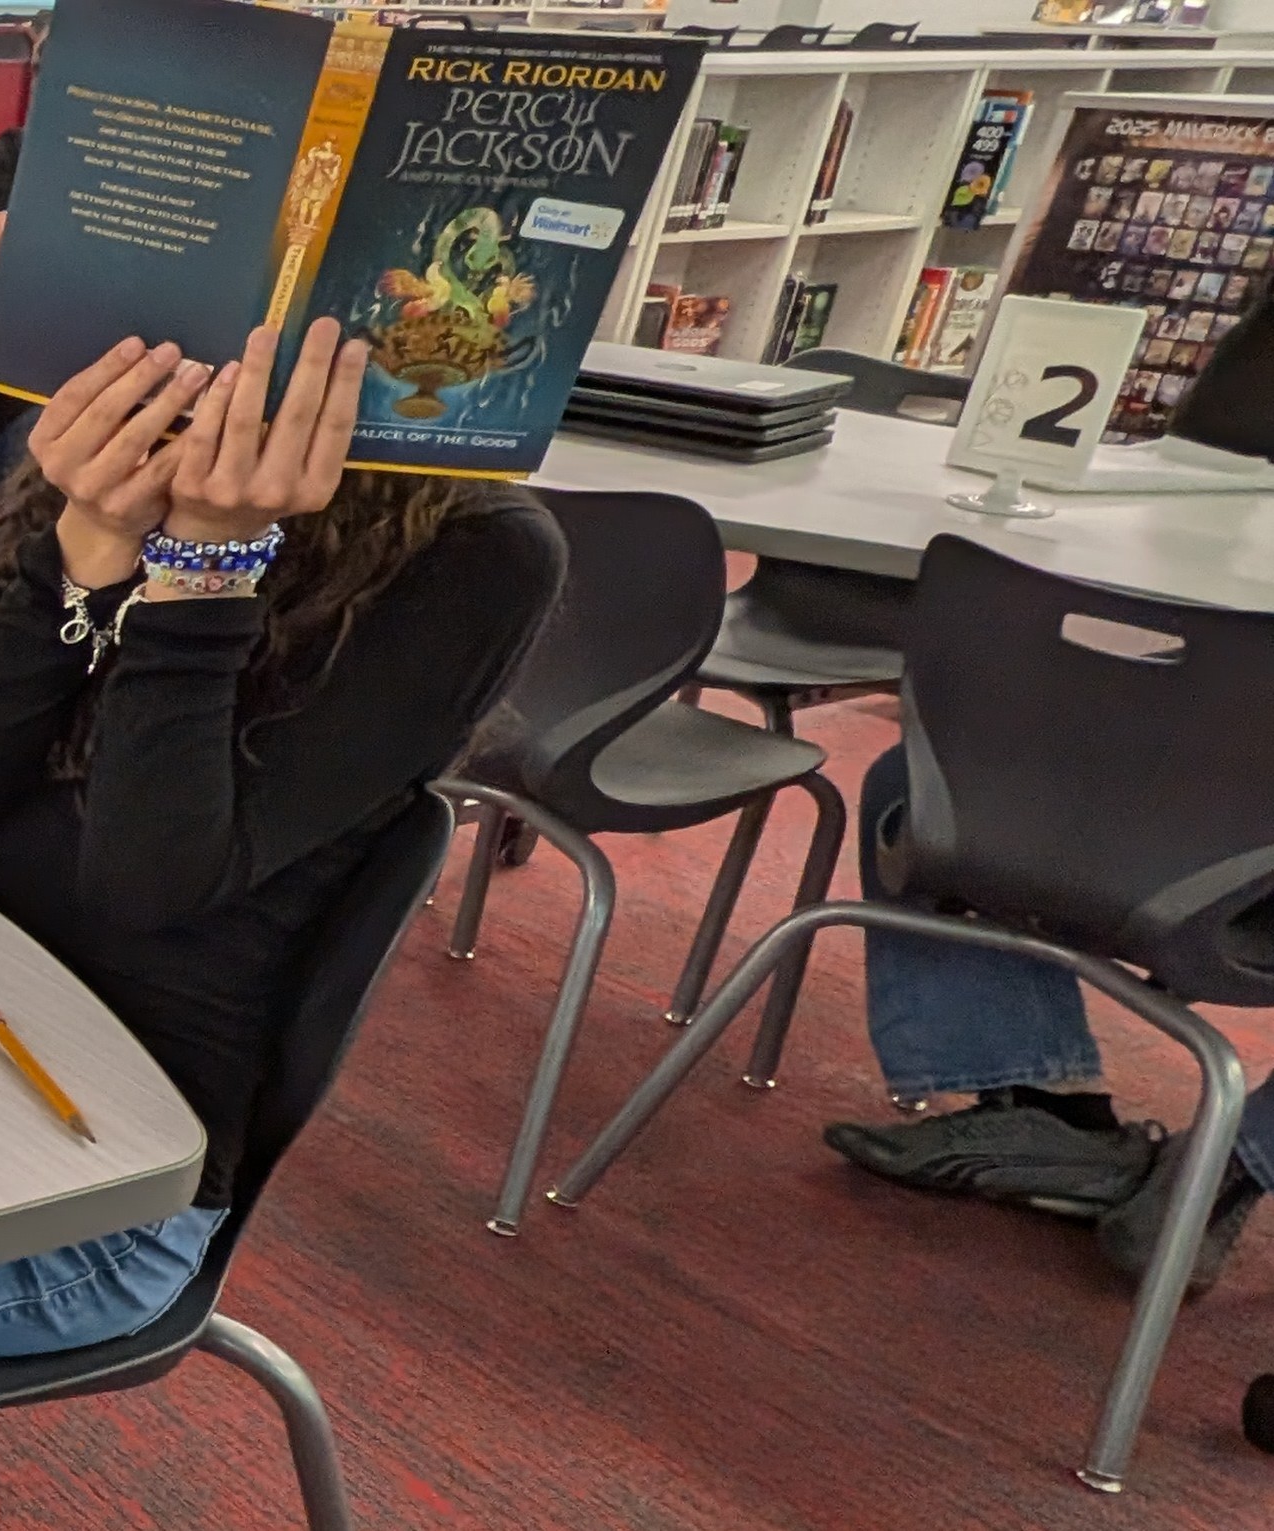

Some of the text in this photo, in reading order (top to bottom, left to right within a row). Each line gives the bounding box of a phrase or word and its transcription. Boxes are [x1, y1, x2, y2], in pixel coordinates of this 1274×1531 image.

[407, 57, 667, 92] RICK RIORDAN
[442, 87, 606, 131] PERCY
[386, 121, 636, 178] JACKSON
[972, 139, 1000, 152] 499
[533, 215, 591, 237] Walmart
[1019, 364, 1099, 448] 2
[353, 429, 518, 449] ALICE OF THE GODS
